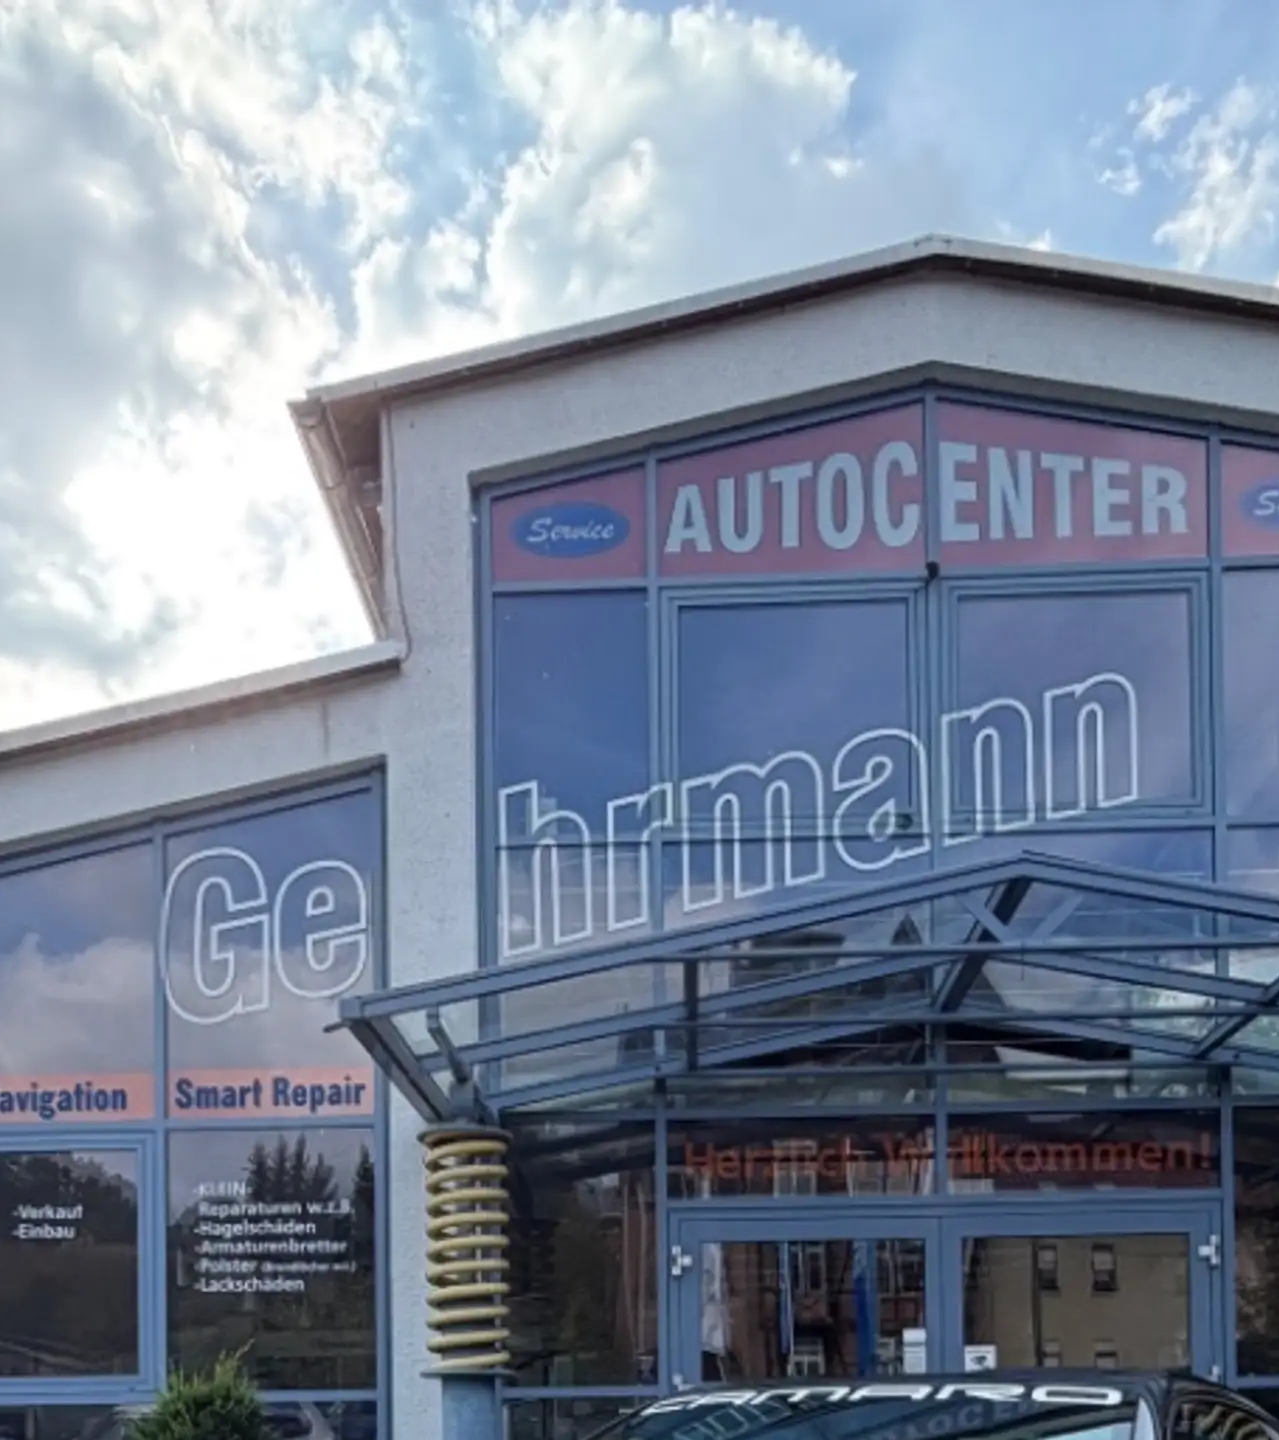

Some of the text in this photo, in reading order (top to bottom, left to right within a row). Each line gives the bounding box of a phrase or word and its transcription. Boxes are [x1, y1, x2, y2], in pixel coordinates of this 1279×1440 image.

[664, 440, 1191, 553] AUTOCENTER
[526, 515, 615, 542] Service
[175, 1073, 366, 1113] Smart Repair
[199, 1201, 302, 1218] Reparaturen
